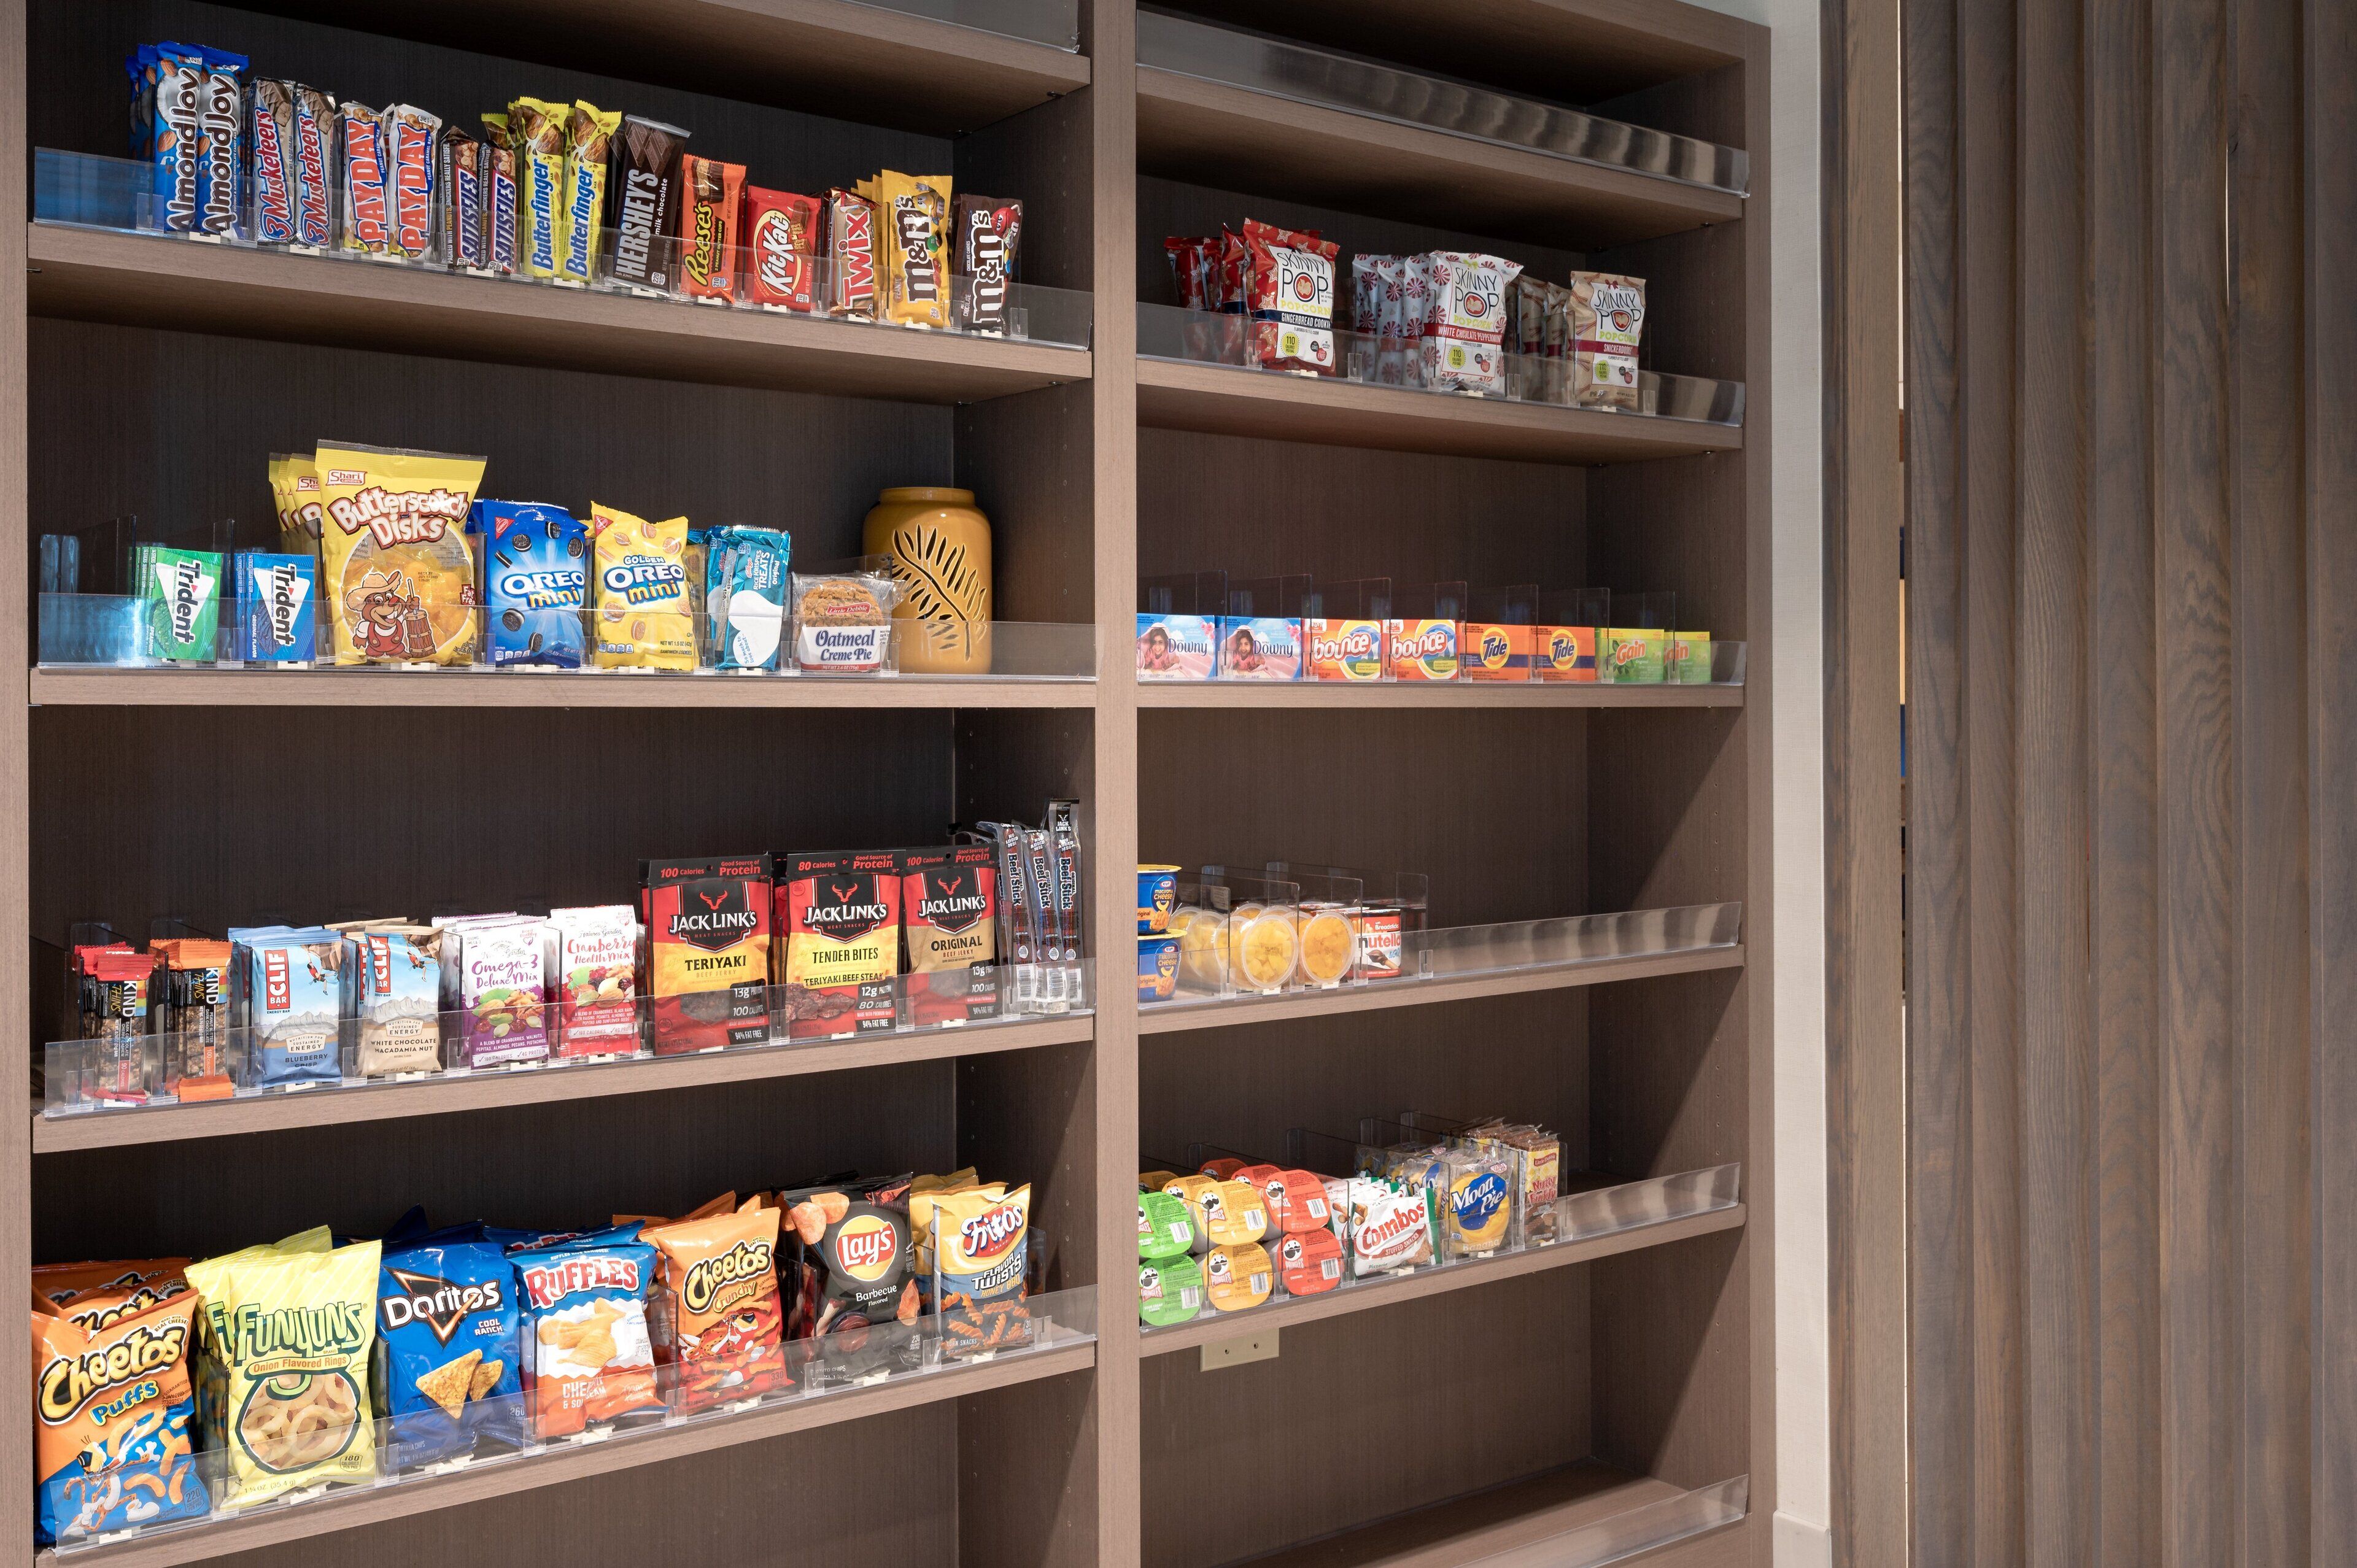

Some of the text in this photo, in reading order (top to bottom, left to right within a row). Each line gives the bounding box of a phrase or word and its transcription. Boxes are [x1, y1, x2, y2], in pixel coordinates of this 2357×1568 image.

[167, 68, 199, 230] Almond Joy
[203, 74, 238, 232] Almond Joy
[256, 110, 293, 239] 3 Musketeers
[299, 115, 329, 245] 3 Musketeers
[346, 119, 388, 243] PAYDAY
[398, 124, 428, 250] PAYDAY
[657, 179, 667, 216] chocolate
[460, 171, 481, 266] SATISFIES
[495, 177, 516, 268] SATISFIES
[533, 158, 553, 271] Butterfinger
[565, 165, 594, 277] Butterfinger
[616, 169, 658, 277] HERSHEY'S
[1277, 252, 1325, 274] SKINNY
[1282, 268, 1329, 304] POP
[1455, 267, 1497, 292] SKINNY
[1280, 300, 1331, 315] POPCORN
[1455, 286, 1500, 319] POP
[1595, 290, 1636, 309] SKINNY
[1282, 312, 1314, 325] GINGERBREAD
[1453, 314, 1492, 330] POPCORN
[1596, 308, 1641, 333] POP
[1439, 326, 1503, 343] WHITE CHOCOLATE PEPPERMINT
[1600, 331, 1637, 344] POPCORN
[330, 488, 468, 534] Butterscotch
[372, 516, 446, 547] Disks
[624, 555, 664, 565] GOLDEN
[759, 552, 770, 589] TREATS
[503, 572, 584, 593] OREO
[606, 565, 683, 586] OREO
[174, 562, 200, 644] Trident
[529, 587, 579, 608] mini
[628, 582, 680, 603] mini
[275, 565, 296, 645] Trident
[816, 629, 874, 647] Oatmeal
[1168, 639, 1207, 657] Downy
[1253, 639, 1293, 657] Downy
[1313, 634, 1371, 660] bounce
[1391, 633, 1446, 658] bounce
[1482, 638, 1507, 662] Tide
[821, 647, 872, 661] Creme Pie
[1552, 639, 1575, 662] Tide
[1616, 641, 1645, 665] Gain
[798, 861, 811, 871] 80
[853, 859, 893, 869] Protein
[907, 857, 921, 865] 100
[955, 852, 989, 862] Protein
[660, 868, 678, 878] 100
[719, 865, 761, 876] Protein
[1060, 857, 1072, 884] Beef
[919, 895, 986, 916] JACK LINK'S
[1061, 883, 1072, 910] Stick
[669, 911, 757, 933] JACK LINK'S
[803, 903, 888, 924] JACK LINK'S
[567, 937, 636, 954] Cranberry
[931, 935, 983, 951] ORIGINAL
[1358, 933, 1401, 948] nutella
[373, 938, 388, 980] CLIF
[471, 954, 538, 979] Omega-3
[575, 951, 630, 964] Health Mix
[684, 955, 747, 971] TERIYAKI
[813, 948, 878, 964] TENDER BITES
[195, 972, 204, 999] THINS
[206, 968, 219, 1004] KIND
[269, 953, 286, 996] CLIF
[476, 970, 538, 989] Deluxe Mix
[803, 976, 842, 986] TERIYAKI
[861, 972, 883, 981] STEAK
[110, 985, 122, 1012] THINS
[123, 981, 137, 1017] KIND
[862, 986, 877, 997] 12g
[285, 1053, 328, 1063] BLUEBERRY
[1452, 1176, 1494, 1211] Moon
[1480, 1191, 1503, 1216] Pie
[1529, 1189, 1557, 1203] Buddy
[1532, 1176, 1556, 1192] Nutty
[961, 1204, 1023, 1257] Fritos
[1362, 1202, 1425, 1250] Combos
[842, 1228, 892, 1267] Lay's
[1385, 1232, 1419, 1256] STUFFED SNACKS
[1463, 1239, 1500, 1251] Banana
[971, 1254, 1021, 1290] TWISTS
[983, 1253, 1014, 1278] FLAVOR
[1285, 1259, 1304, 1270] PRINGLES
[525, 1258, 638, 1307] RUFFLES
[685, 1243, 770, 1311] Cheetos
[981, 1275, 1020, 1297] HONEY BBQ
[1211, 1273, 1232, 1286] PRINGLES
[384, 1280, 500, 1327] Doritos
[713, 1281, 756, 1313] Crunchy
[856, 1284, 897, 1302] Barbecue
[868, 1297, 888, 1307] Flavored
[474, 1326, 503, 1335] RANCH
[234, 1302, 365, 1388] FUNYUNS
[41, 1329, 183, 1419] Cheetos
[253, 1357, 347, 1373] Onion Flavored Rings
[90, 1381, 158, 1425] Puffs
